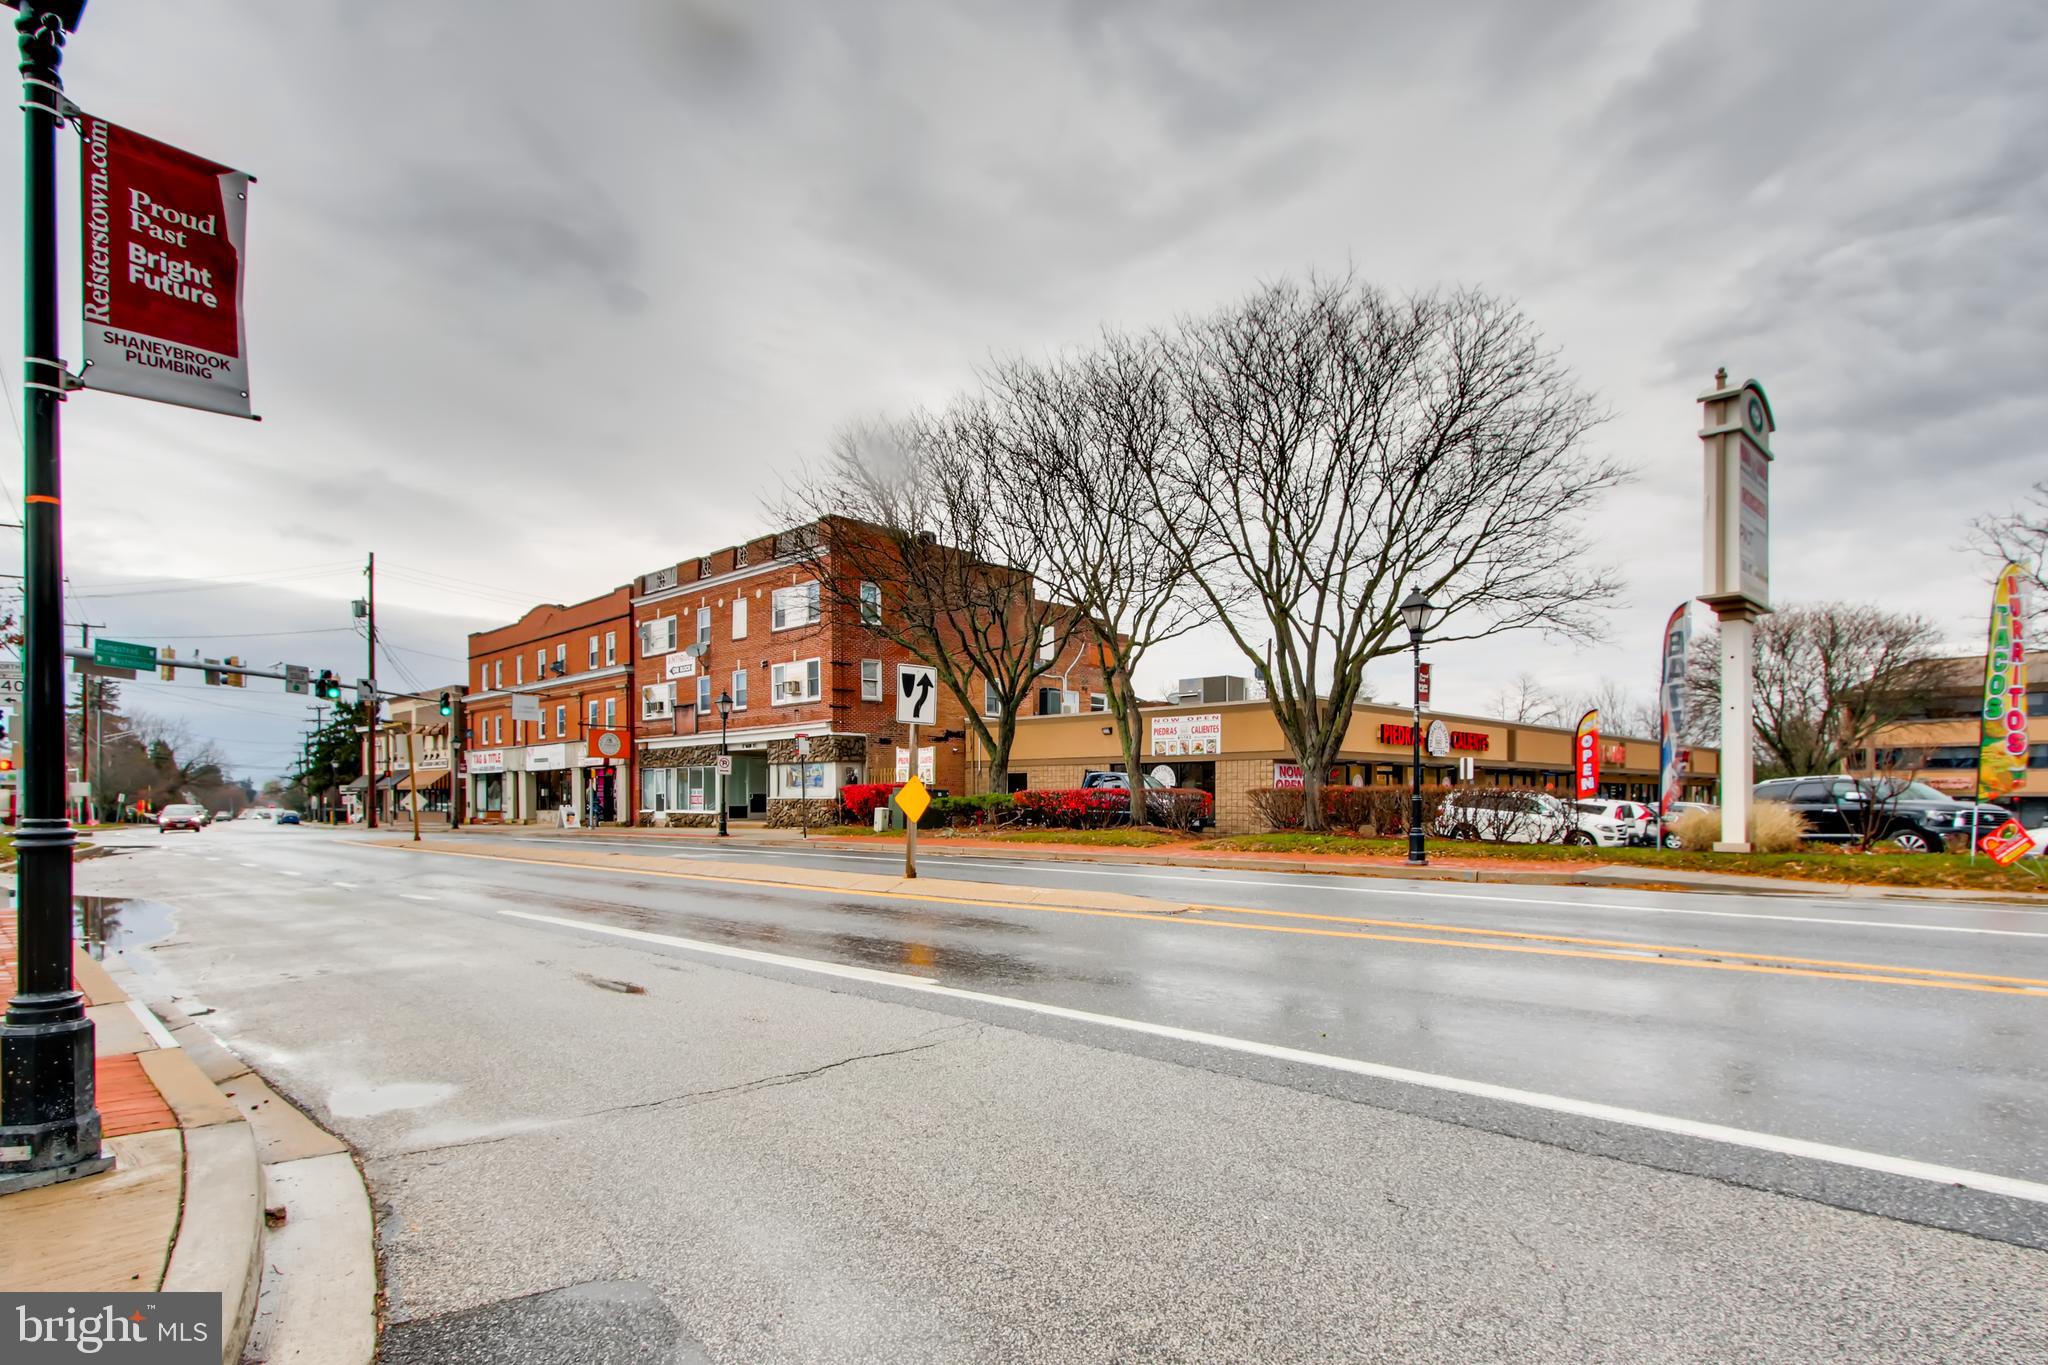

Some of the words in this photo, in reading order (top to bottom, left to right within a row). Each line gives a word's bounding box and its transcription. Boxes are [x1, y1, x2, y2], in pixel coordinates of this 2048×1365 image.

[84, 120, 110, 325] Reisterstown.com
[128, 187, 216, 236] Proud
[128, 208, 187, 248] Past
[128, 241, 213, 289] Bright
[128, 263, 218, 309] Future
[103, 331, 232, 372] SHANEYBROOK
[125, 349, 213, 380] PLUMBING
[1985, 605, 2009, 720] TACOS
[1154, 727, 1177, 735] PIEDRAS
[1191, 725, 1220, 734] CALIENTES
[1279, 766, 1304, 778] NOW
[1581, 734, 1595, 791] OPEN
[1275, 779, 1305, 790] OPEN
